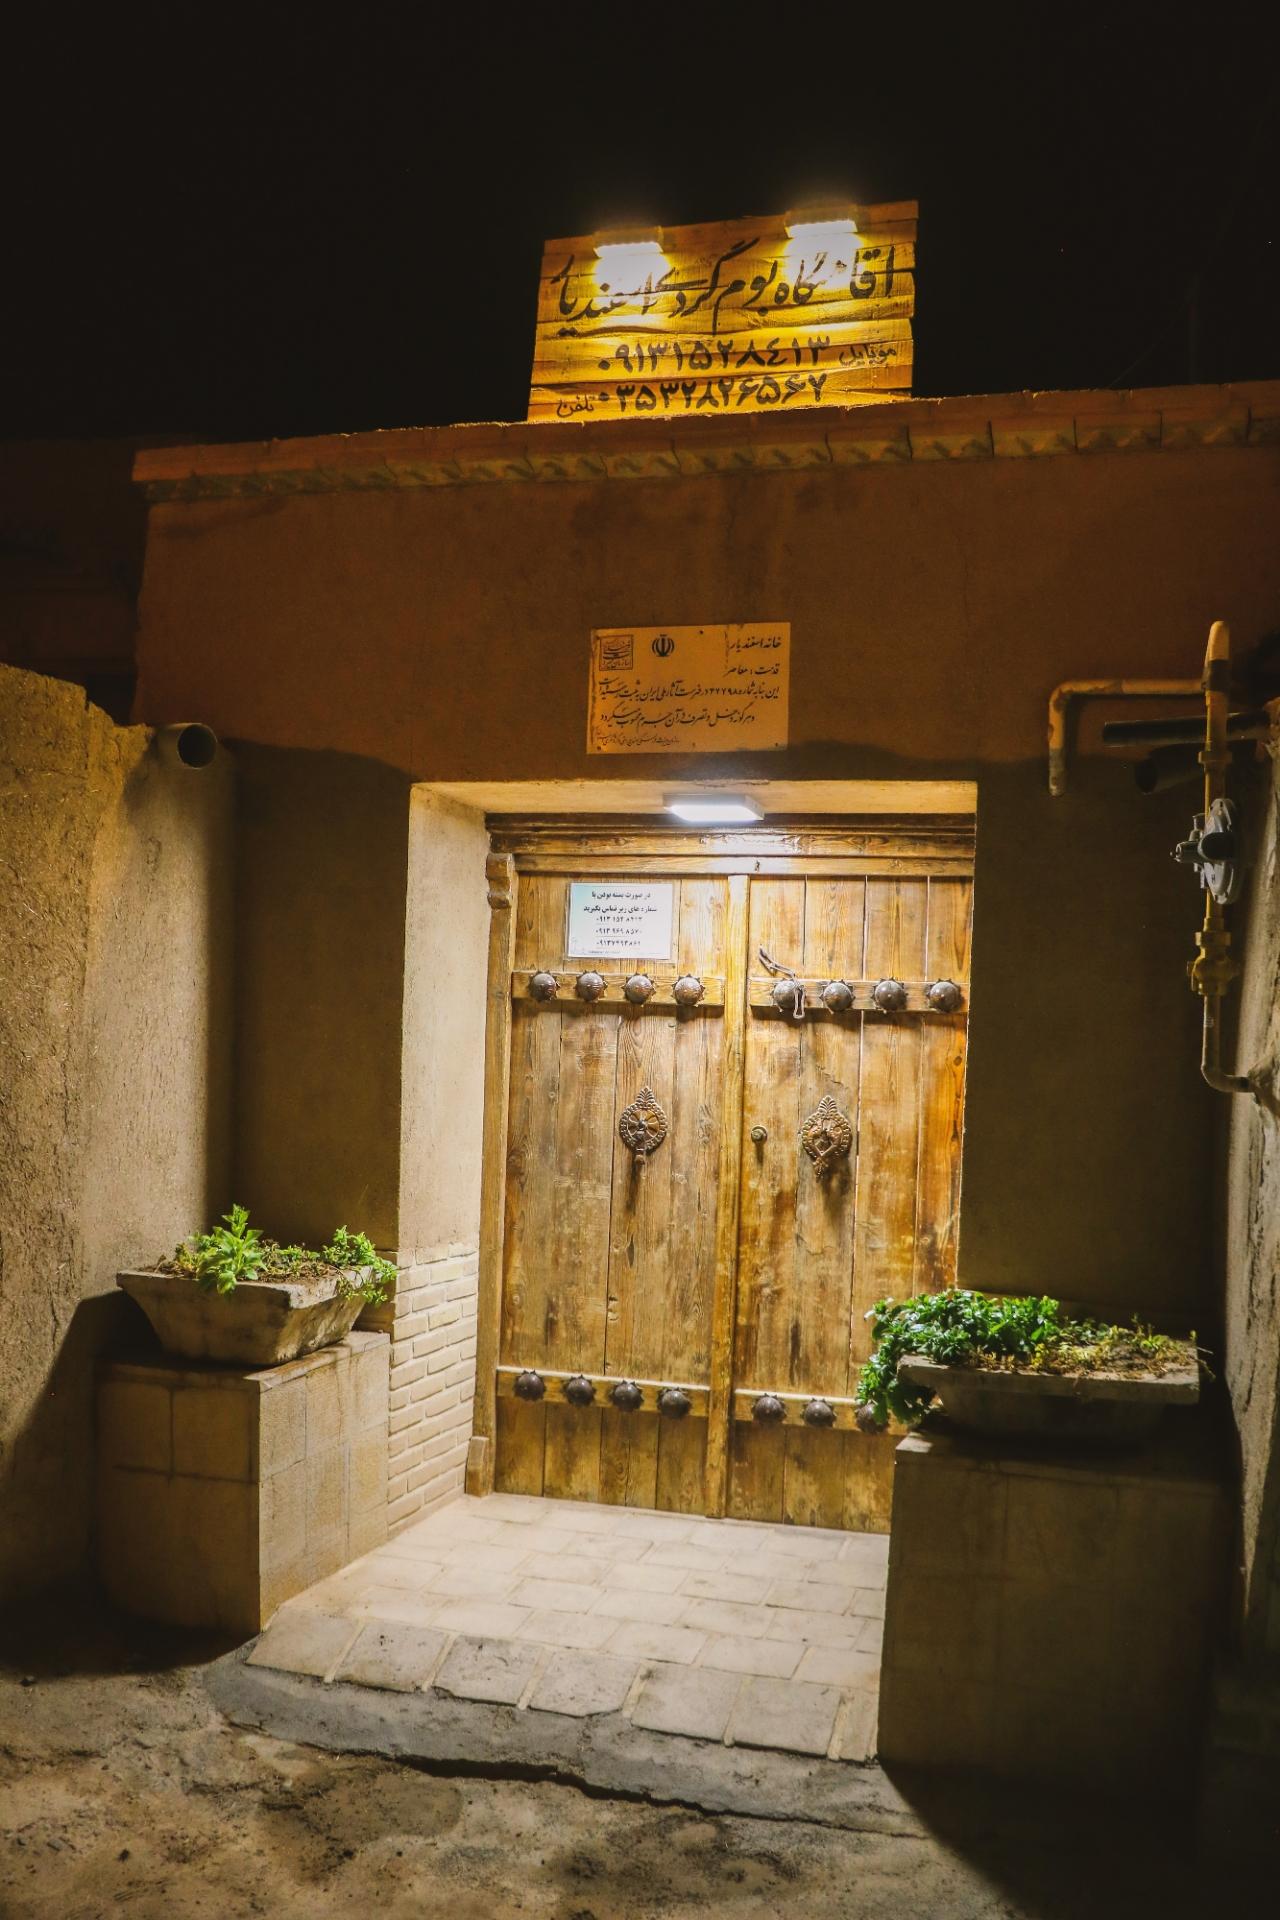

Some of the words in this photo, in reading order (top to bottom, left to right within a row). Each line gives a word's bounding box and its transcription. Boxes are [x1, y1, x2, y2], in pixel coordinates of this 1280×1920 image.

[774, 245, 895, 305] اقاتگاه
[550, 254, 657, 337] اندیار
[711, 260, 778, 336] بوم
[838, 344, 897, 366] موبایل
[556, 394, 595, 418] تلفن
[730, 636, 764, 653] اسفندیار
[763, 636, 781, 648] خانه
[723, 665, 748, 677] معاصر
[765, 686, 780, 699] این
[625, 892, 643, 900] صورت
[583, 904, 601, 914] بگیرید
[601, 905, 618, 914] تماس
